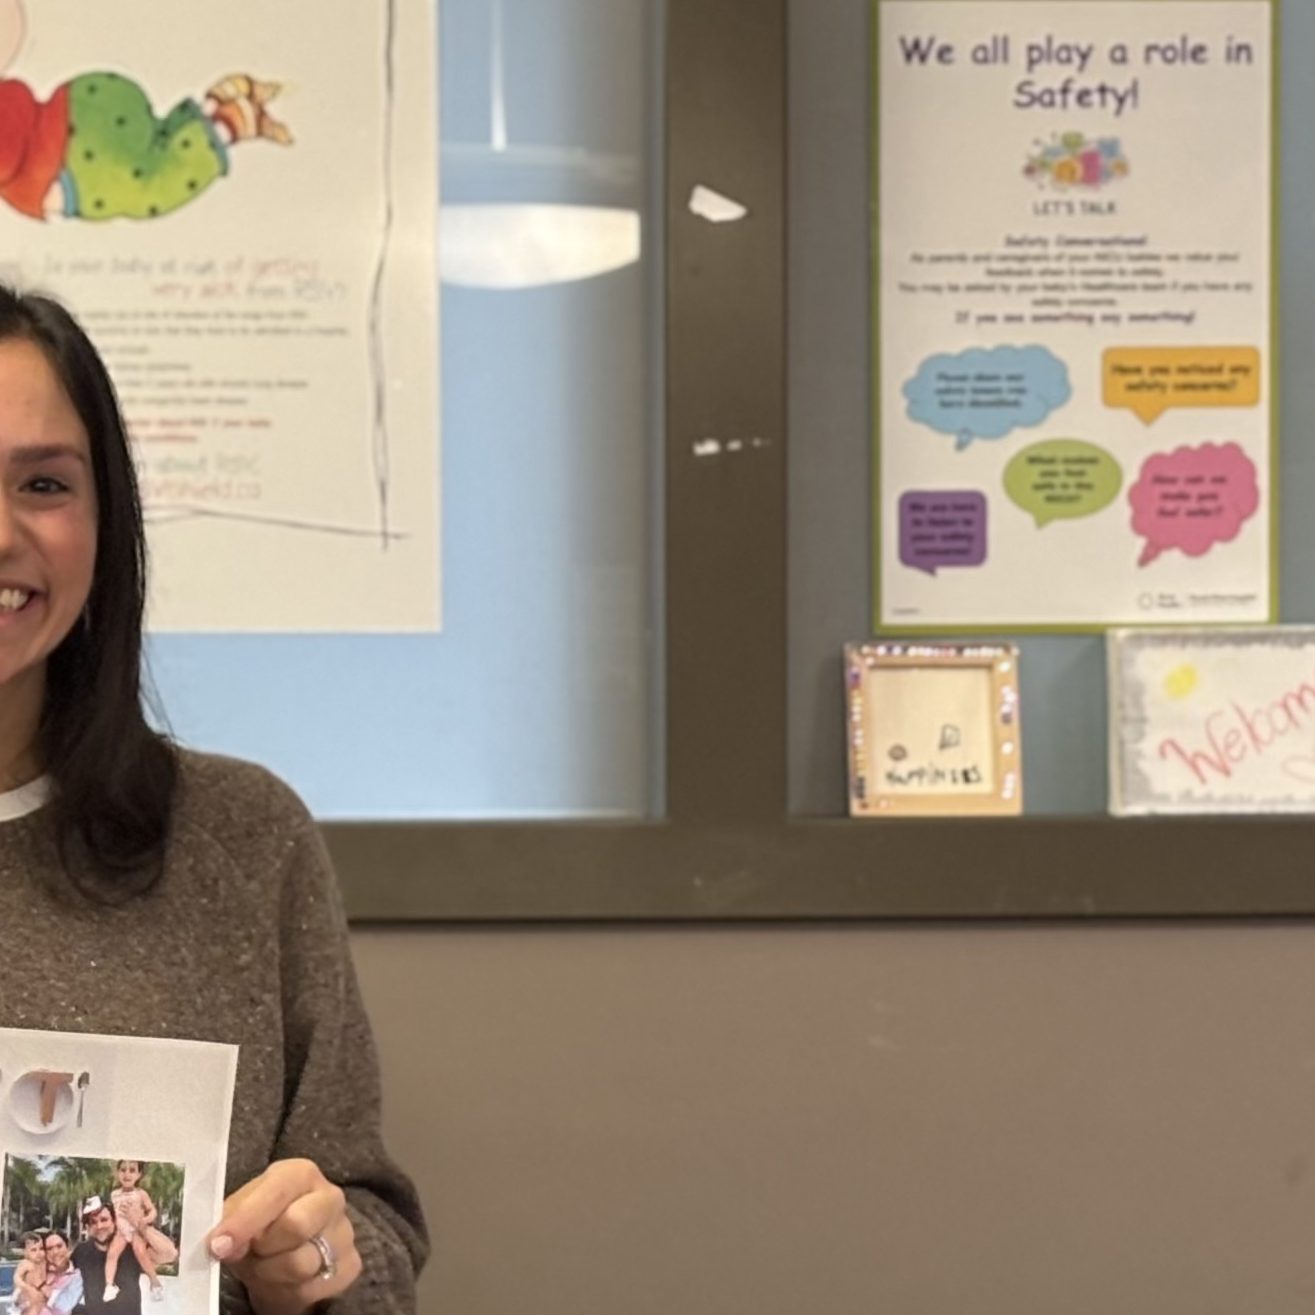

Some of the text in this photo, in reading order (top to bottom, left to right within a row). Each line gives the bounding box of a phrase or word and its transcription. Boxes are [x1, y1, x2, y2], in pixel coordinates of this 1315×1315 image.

[899, 35, 1254, 73] We all play a role in
[1013, 78, 1139, 117] Safety!
[1032, 201, 1117, 216] LET'S TALK
